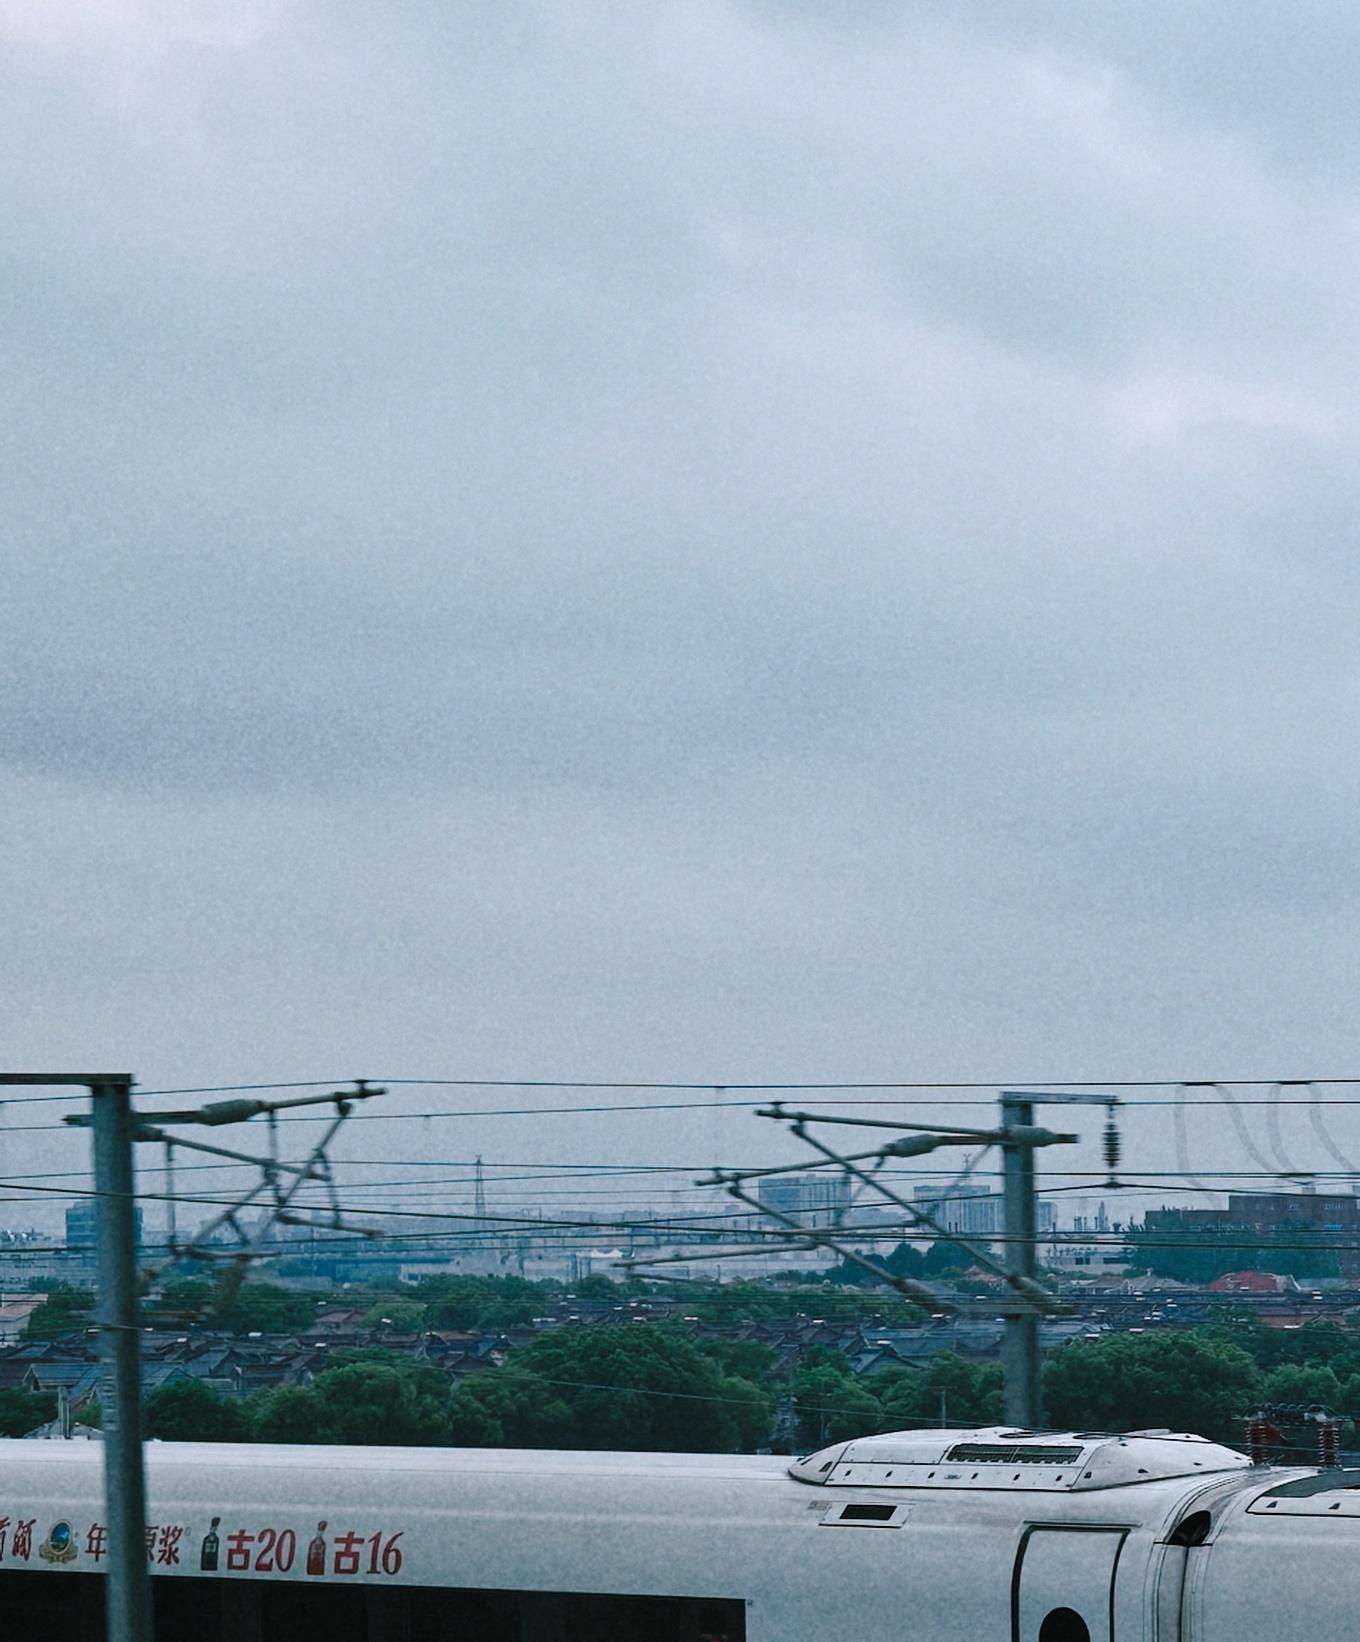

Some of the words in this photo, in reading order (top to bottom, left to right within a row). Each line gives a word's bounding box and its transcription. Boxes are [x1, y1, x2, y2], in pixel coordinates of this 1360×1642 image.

[84, 1522, 184, 1566] 年浆
[226, 1528, 296, 1573] 古20
[333, 1531, 405, 1575] 古16
